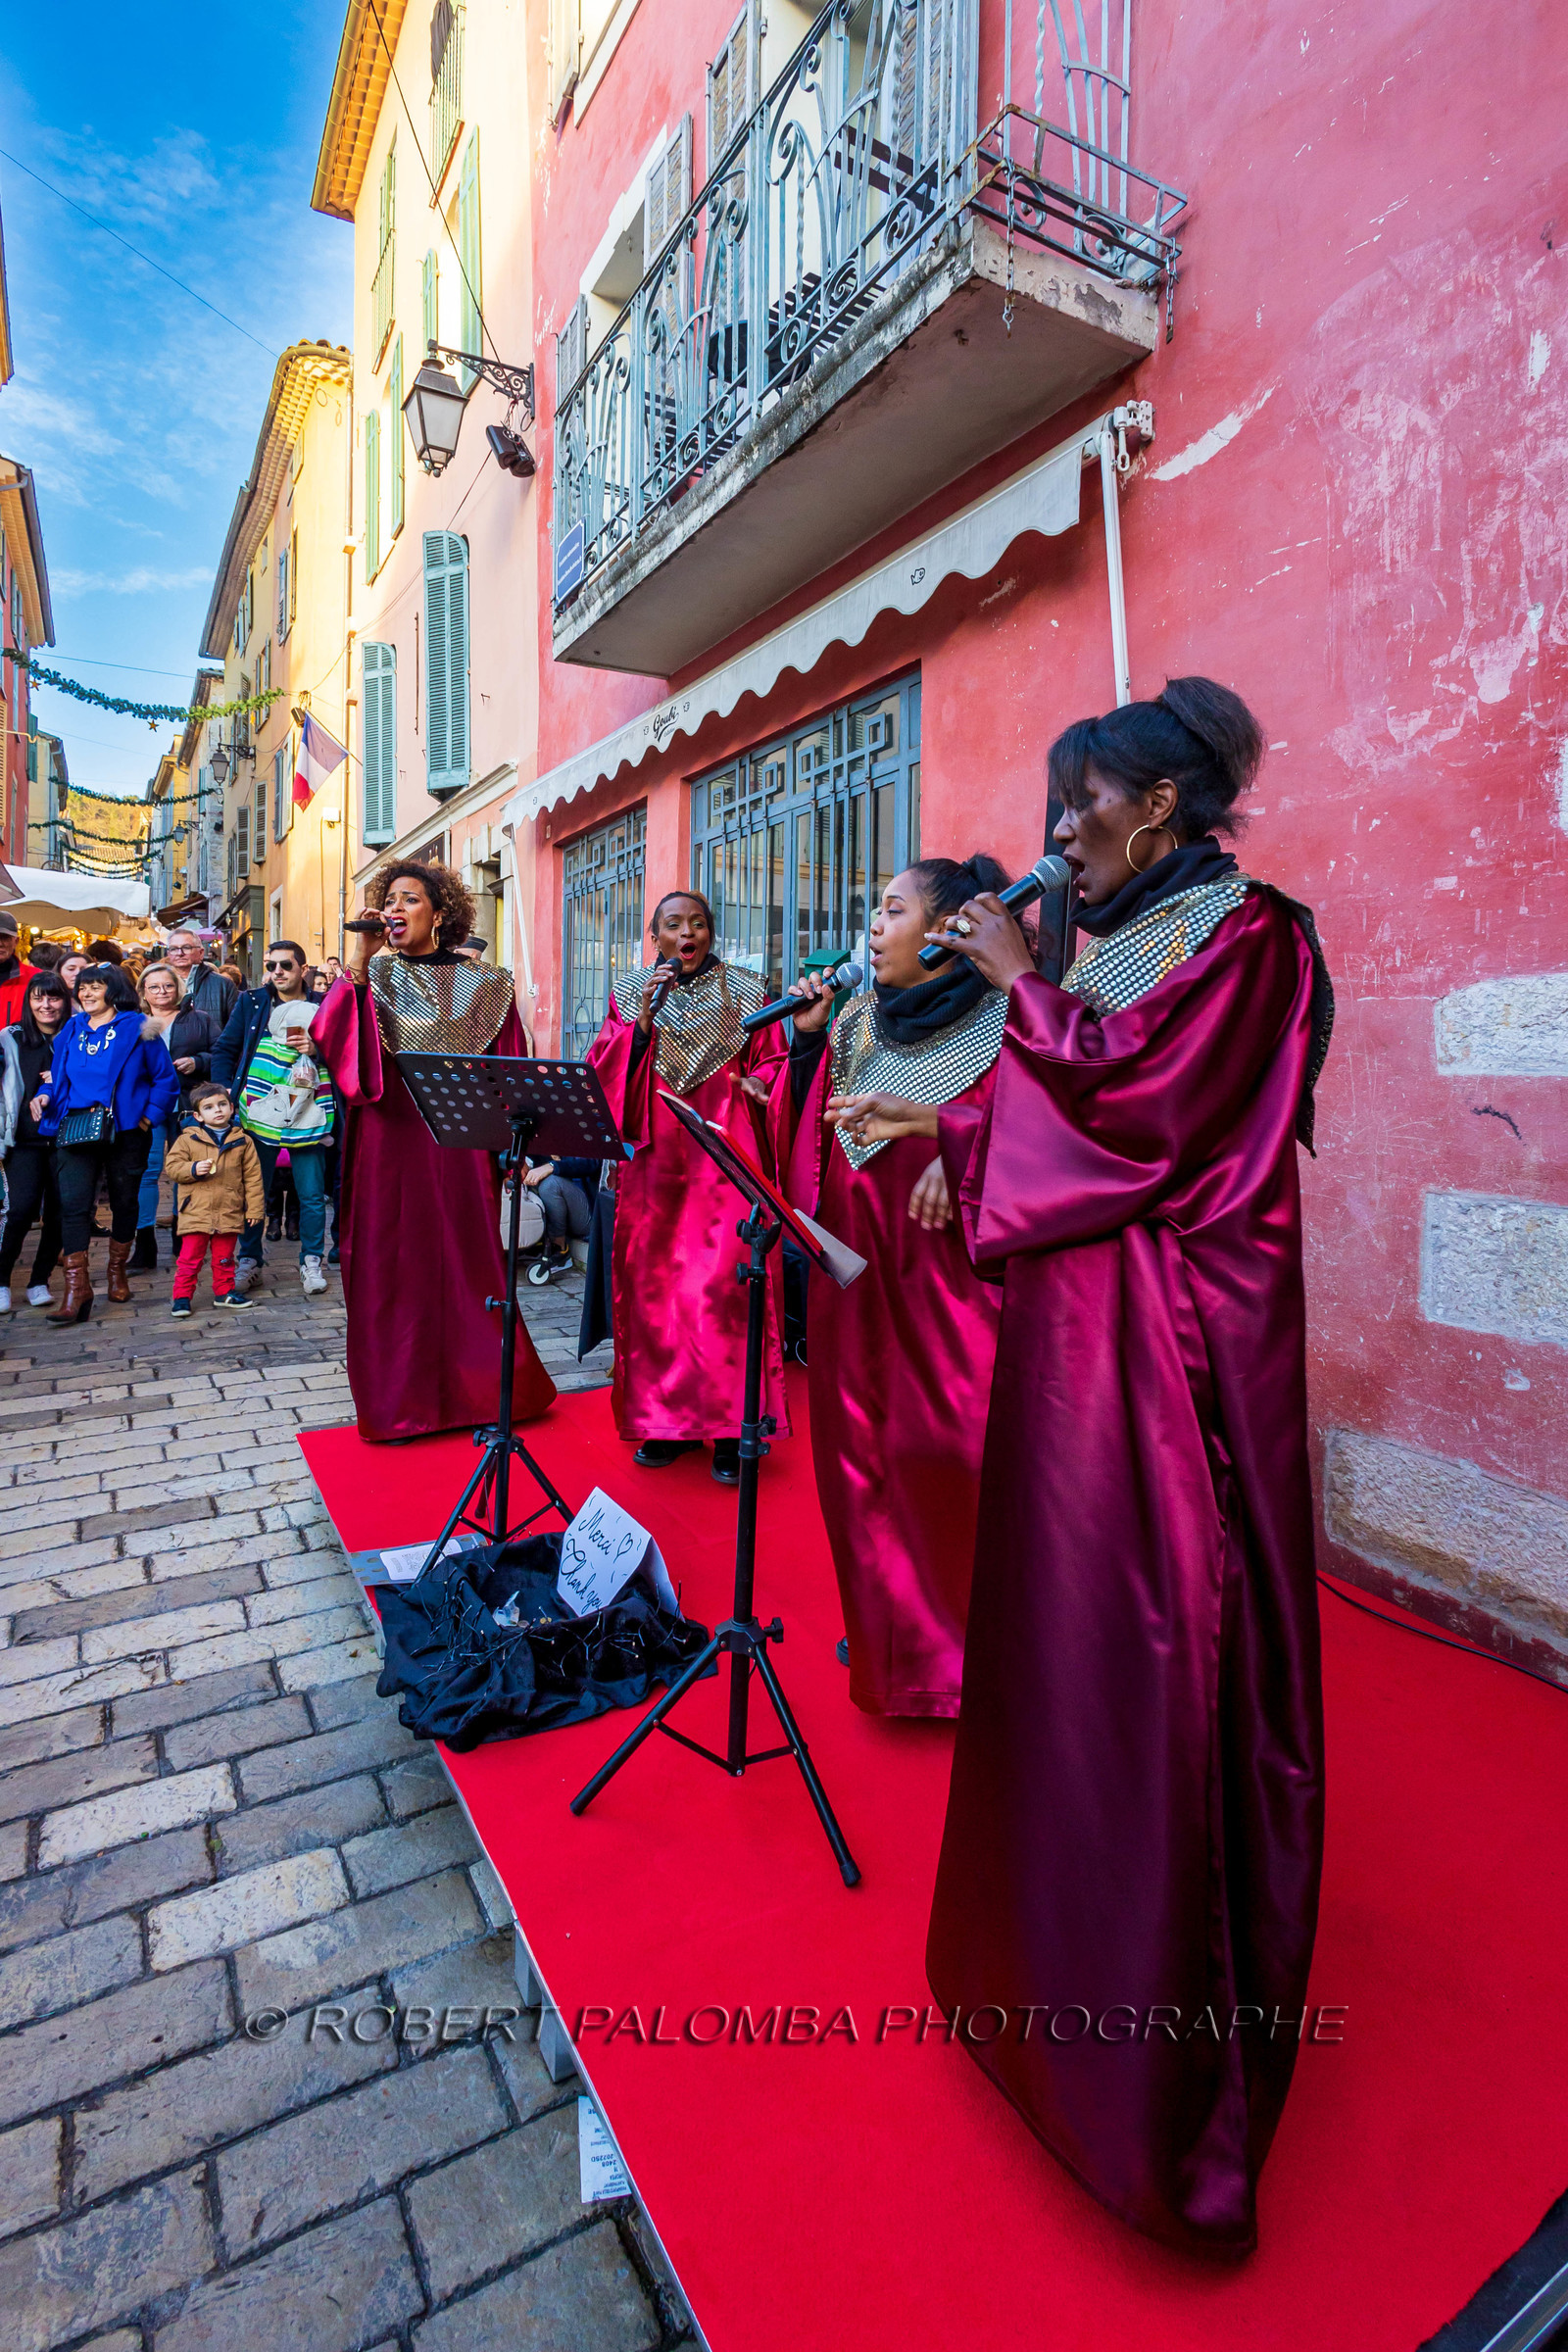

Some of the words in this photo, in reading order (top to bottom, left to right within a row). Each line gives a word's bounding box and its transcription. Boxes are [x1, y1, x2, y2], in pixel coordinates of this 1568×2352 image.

[653, 706, 677, 739] Goubi
[577, 1507, 615, 1556] Merci
[560, 1538, 597, 1600] Thank
